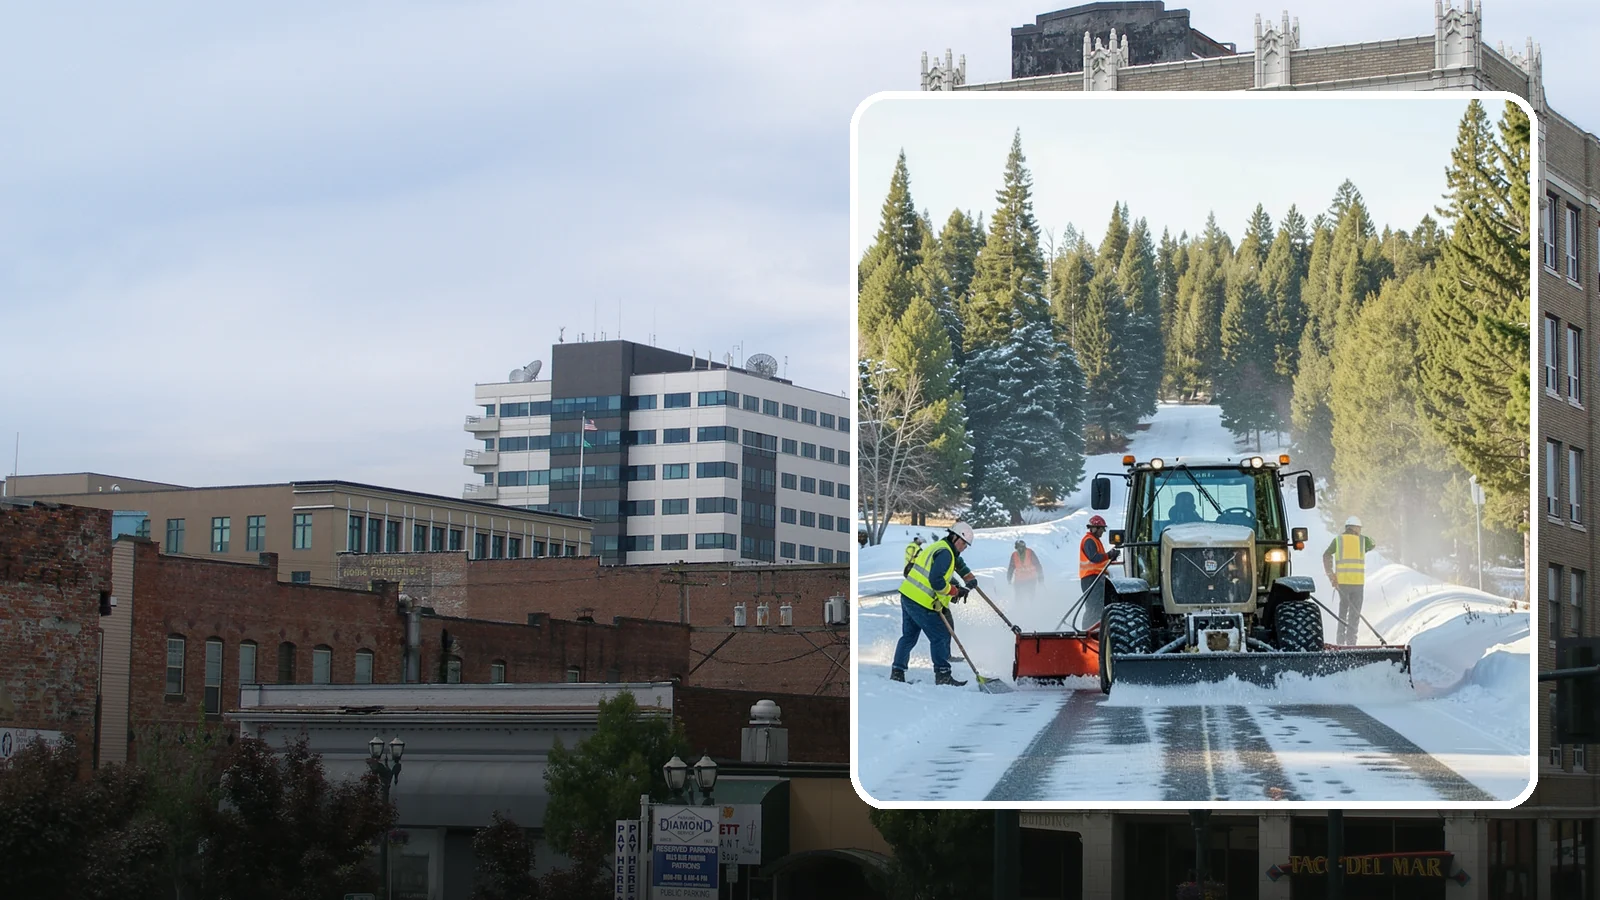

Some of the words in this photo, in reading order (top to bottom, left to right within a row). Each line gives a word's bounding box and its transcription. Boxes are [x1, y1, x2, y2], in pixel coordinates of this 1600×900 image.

[660, 818, 713, 833] DIAMOND
[1021, 815, 1069, 827] BUILDING
[617, 824, 625, 852] PAY
[628, 824, 637, 852] PAY
[656, 845, 688, 853] RESERVED
[689, 846, 716, 854] PARKING
[616, 856, 625, 893] HERE
[627, 856, 636, 893] HERE
[671, 862, 701, 870] PATRONS
[1346, 857, 1385, 876] DEL
[1392, 857, 1442, 877] MAR
[660, 888, 682, 897] PUBLIC
[683, 889, 710, 898] PARKING
